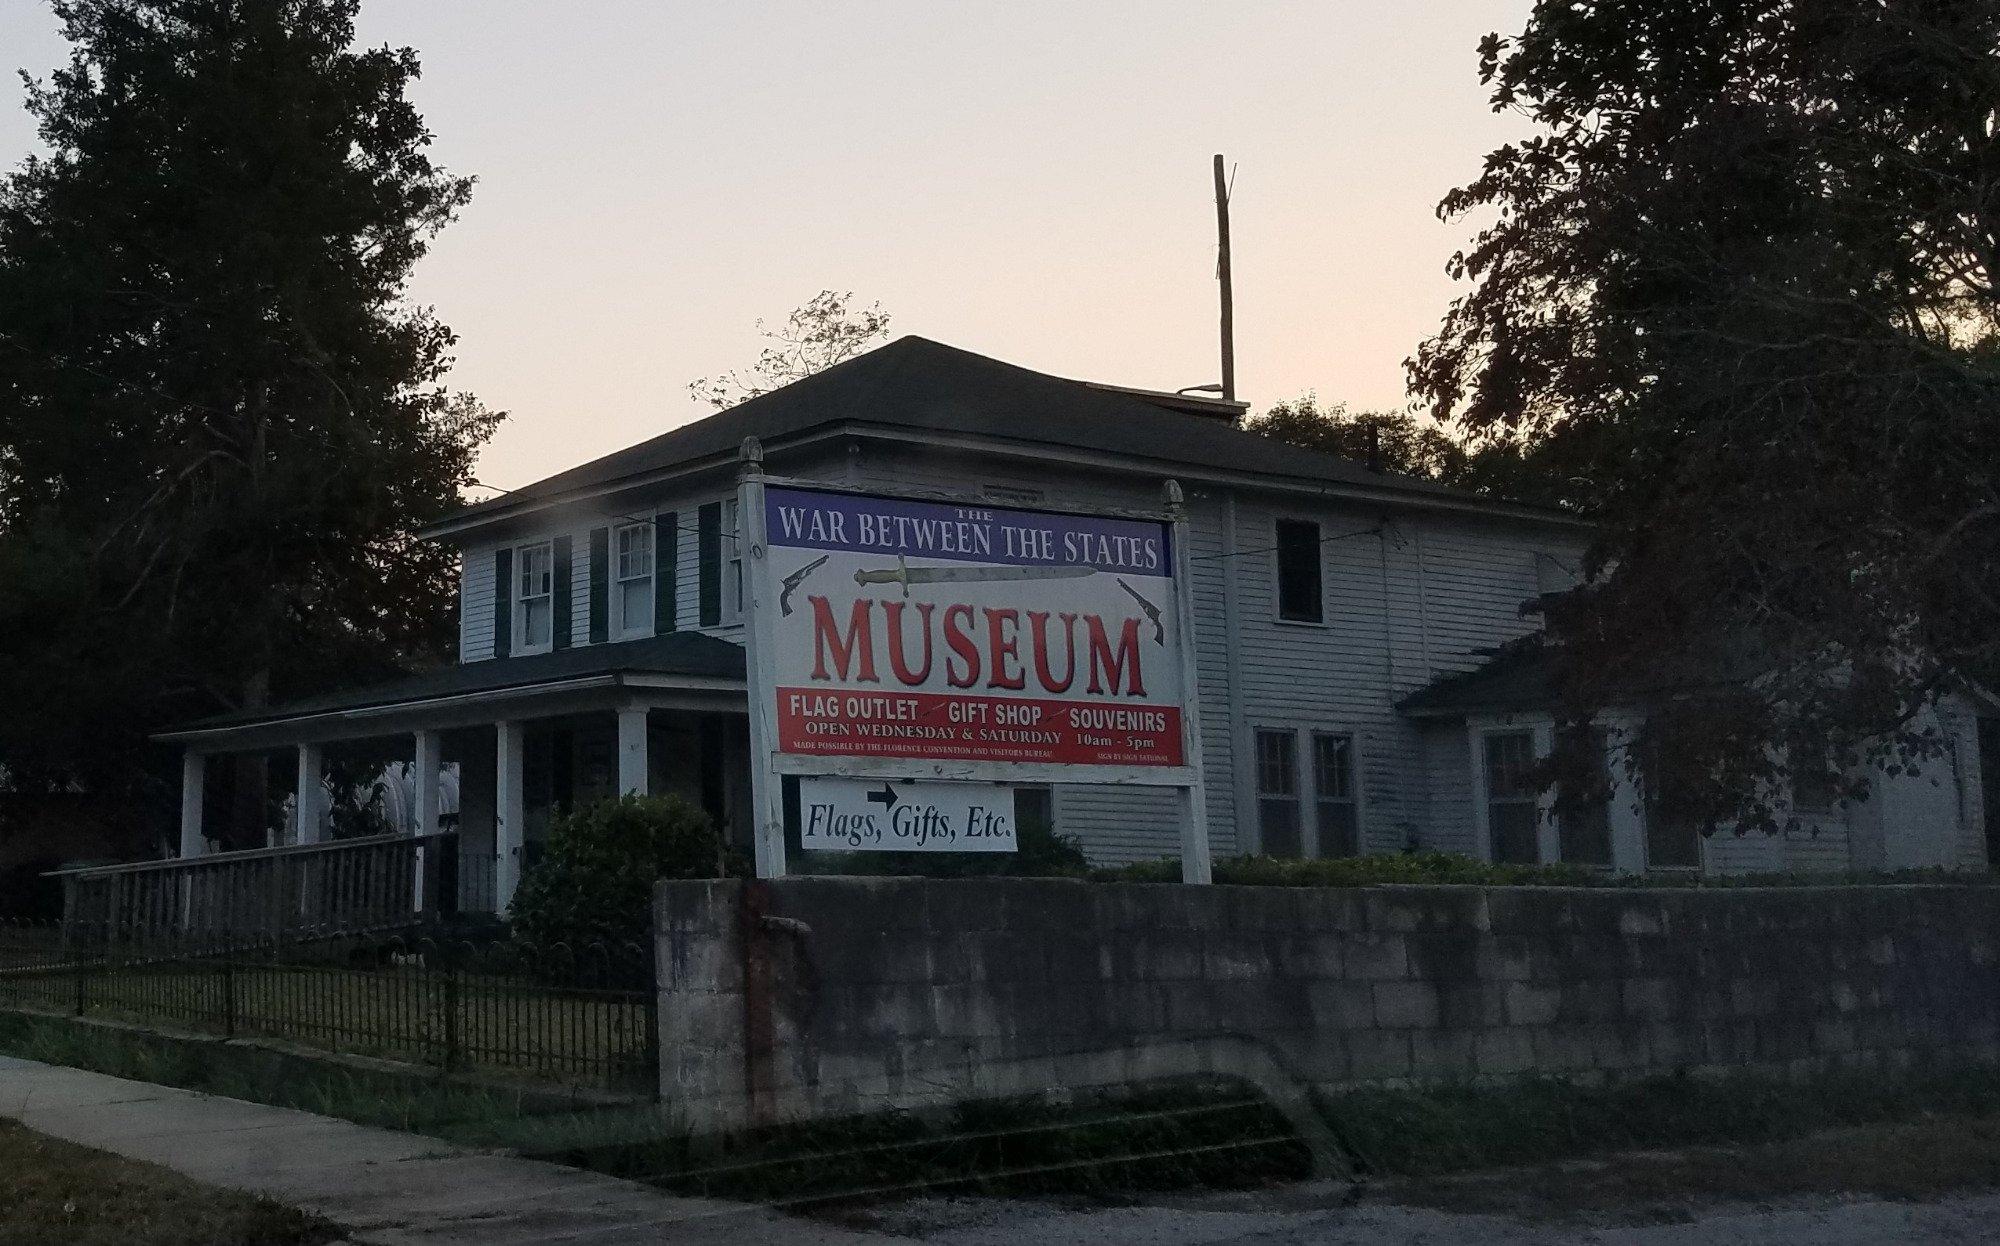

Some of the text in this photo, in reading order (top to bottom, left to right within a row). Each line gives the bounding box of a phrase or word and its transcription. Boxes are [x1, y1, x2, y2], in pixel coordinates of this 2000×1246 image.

[955, 508, 993, 521] THE
[778, 506, 1158, 570] WAR BETWEEN THE STATES
[808, 595, 1147, 698] MUSEUM
[790, 694, 1166, 732] FLAG OUTLET GIFT SHOP SOUVENIRS
[793, 741, 816, 749] MADE
[818, 742, 854, 750] POSSIBLE
[867, 743, 881, 751] THE
[883, 744, 921, 752] FLORENCE
[923, 745, 971, 754] CONVENTION
[973, 747, 987, 755] AND
[1024, 749, 1053, 758] BUREAU
[805, 721, 850, 736] OPEN
[857, 724, 957, 740] WEDNESDAY
[961, 728, 973, 740] &
[979, 728, 1062, 744] SATURDAY
[1077, 733, 1112, 746] 10am
[1126, 736, 1155, 750] 5pm
[805, 804, 1011, 846] Flags, Gifts, Etc.
